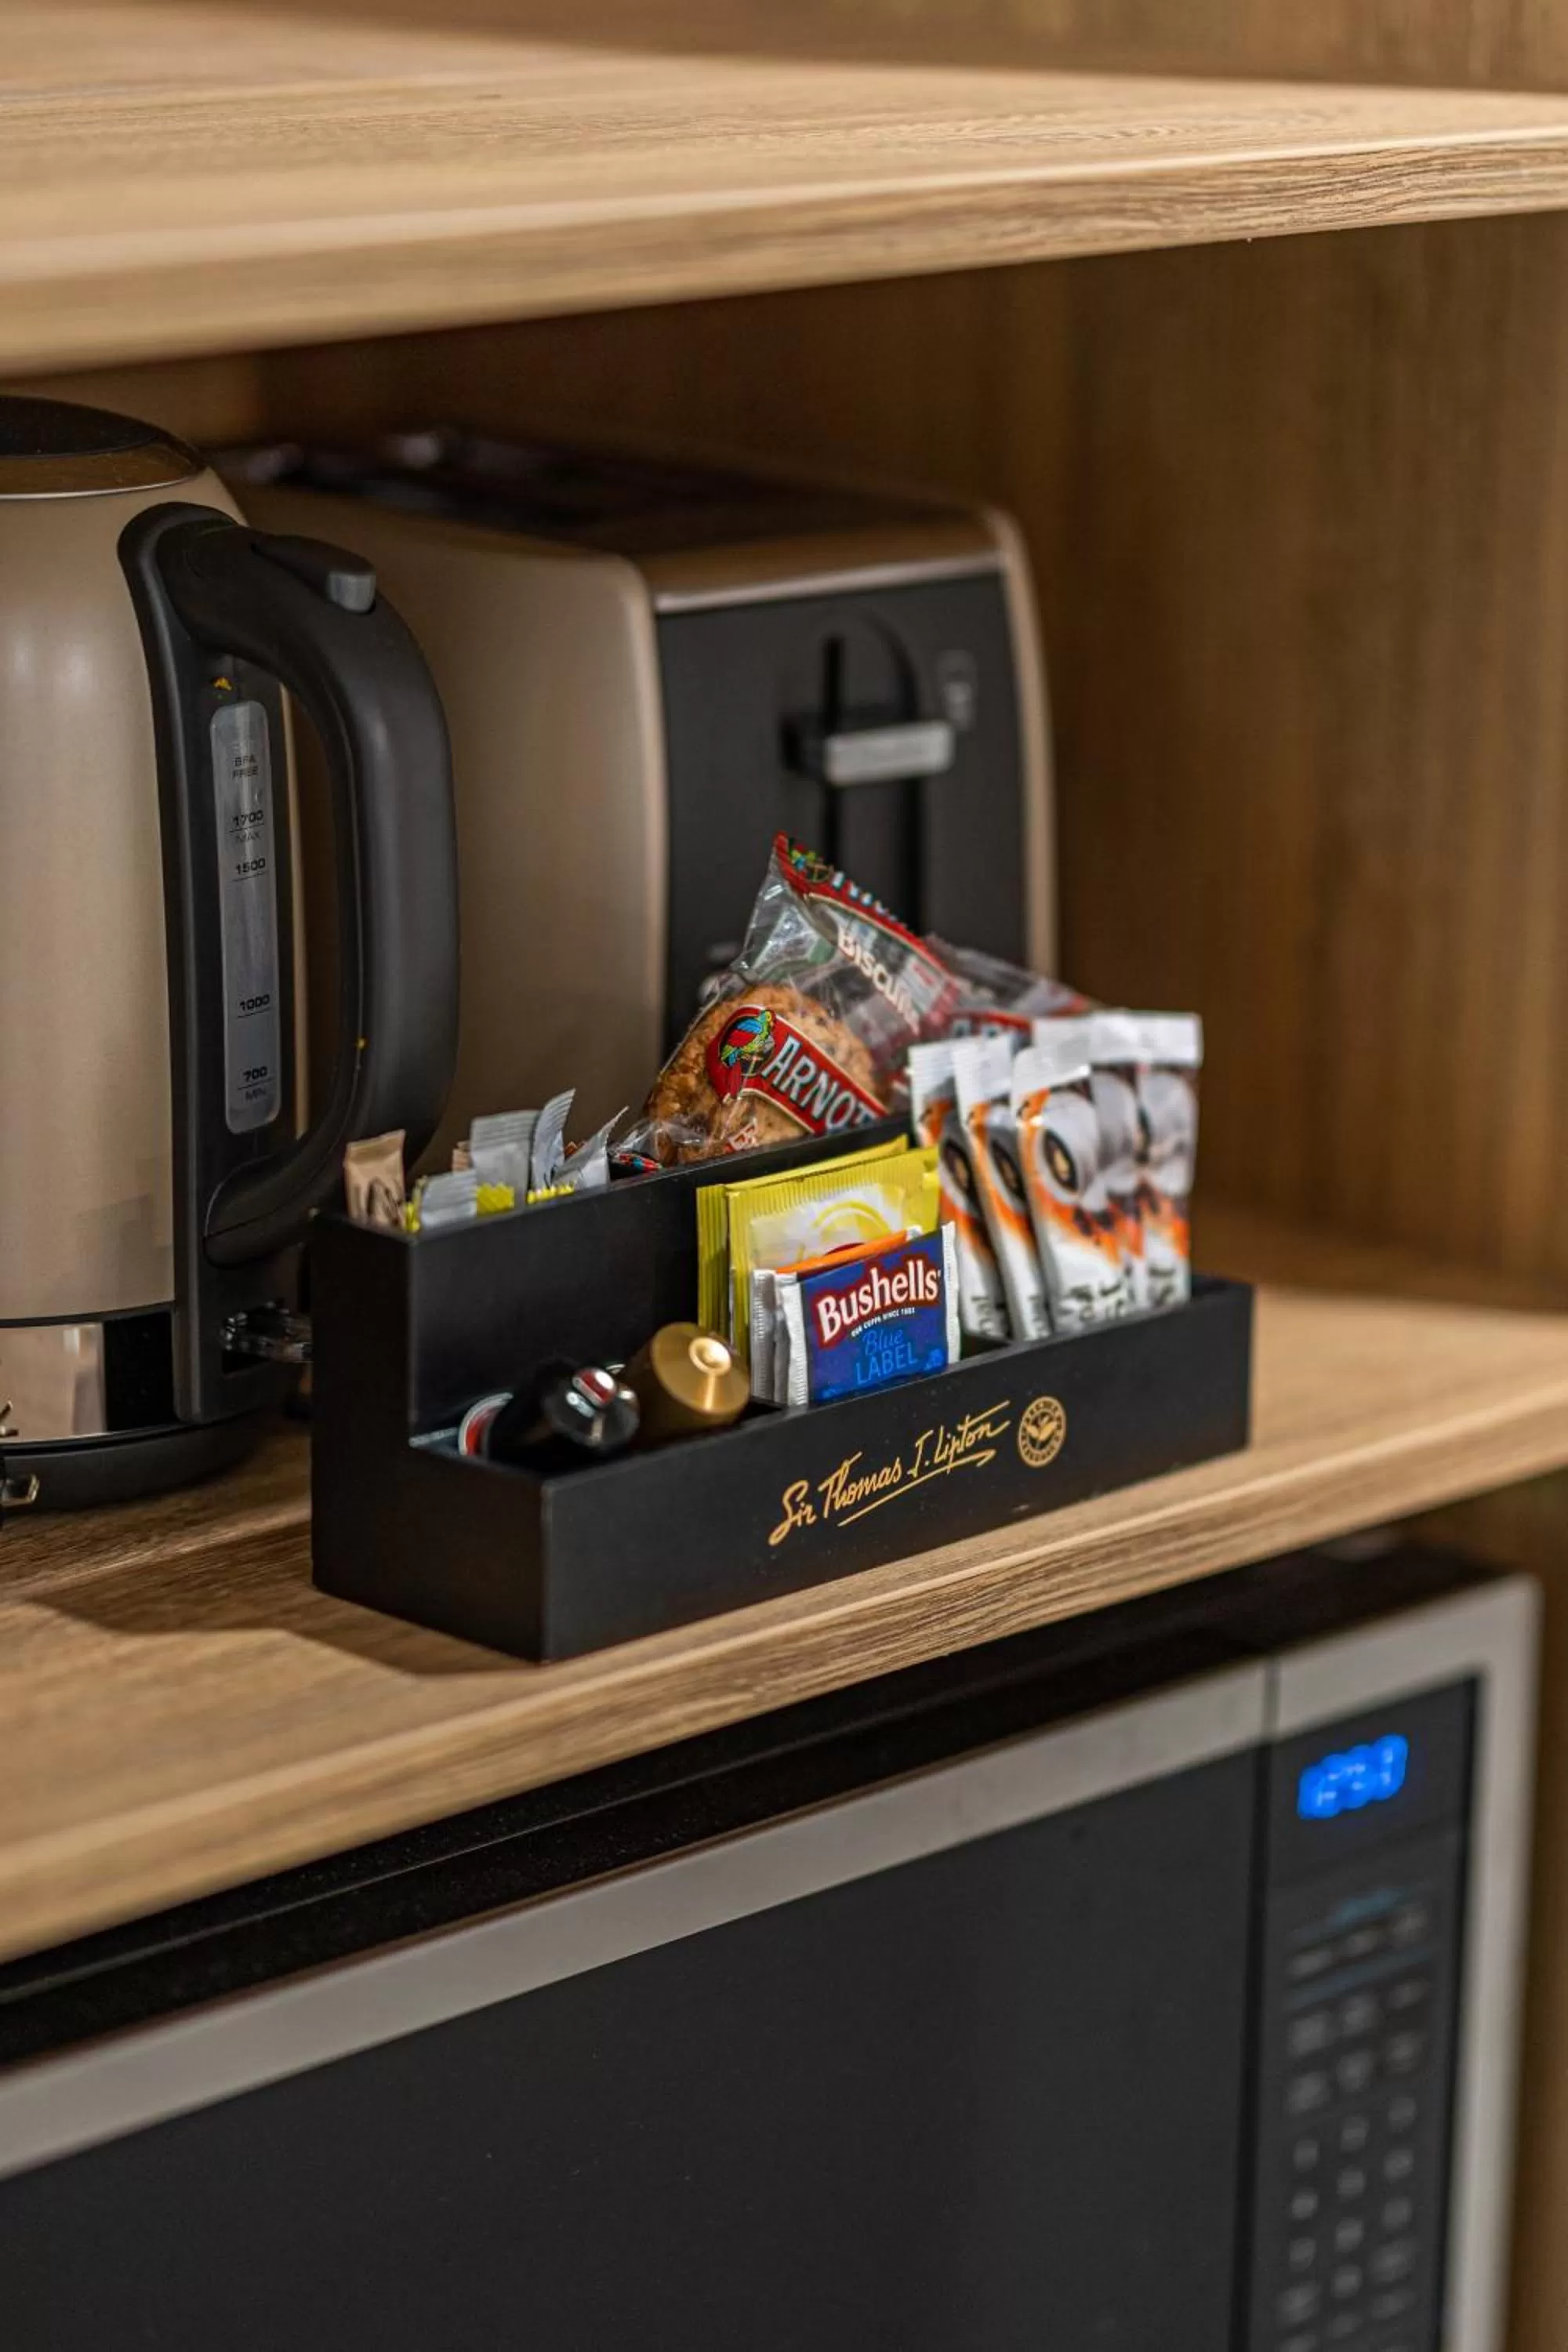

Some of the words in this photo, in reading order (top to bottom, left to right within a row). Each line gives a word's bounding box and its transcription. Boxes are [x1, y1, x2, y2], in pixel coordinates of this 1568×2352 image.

[233, 810, 263, 826] 1700
[236, 858, 266, 874] 1500
[240, 994, 270, 1011] 1000
[243, 1066, 267, 1082] 700
[817, 1259, 939, 1343] Bushells
[862, 1329, 904, 1356] Blue
[855, 1341, 918, 1386] LABEL
[768, 1479, 817, 1546] Sir
[817, 1451, 903, 1519] Thomas
[933, 1399, 1011, 1475] Lipton
